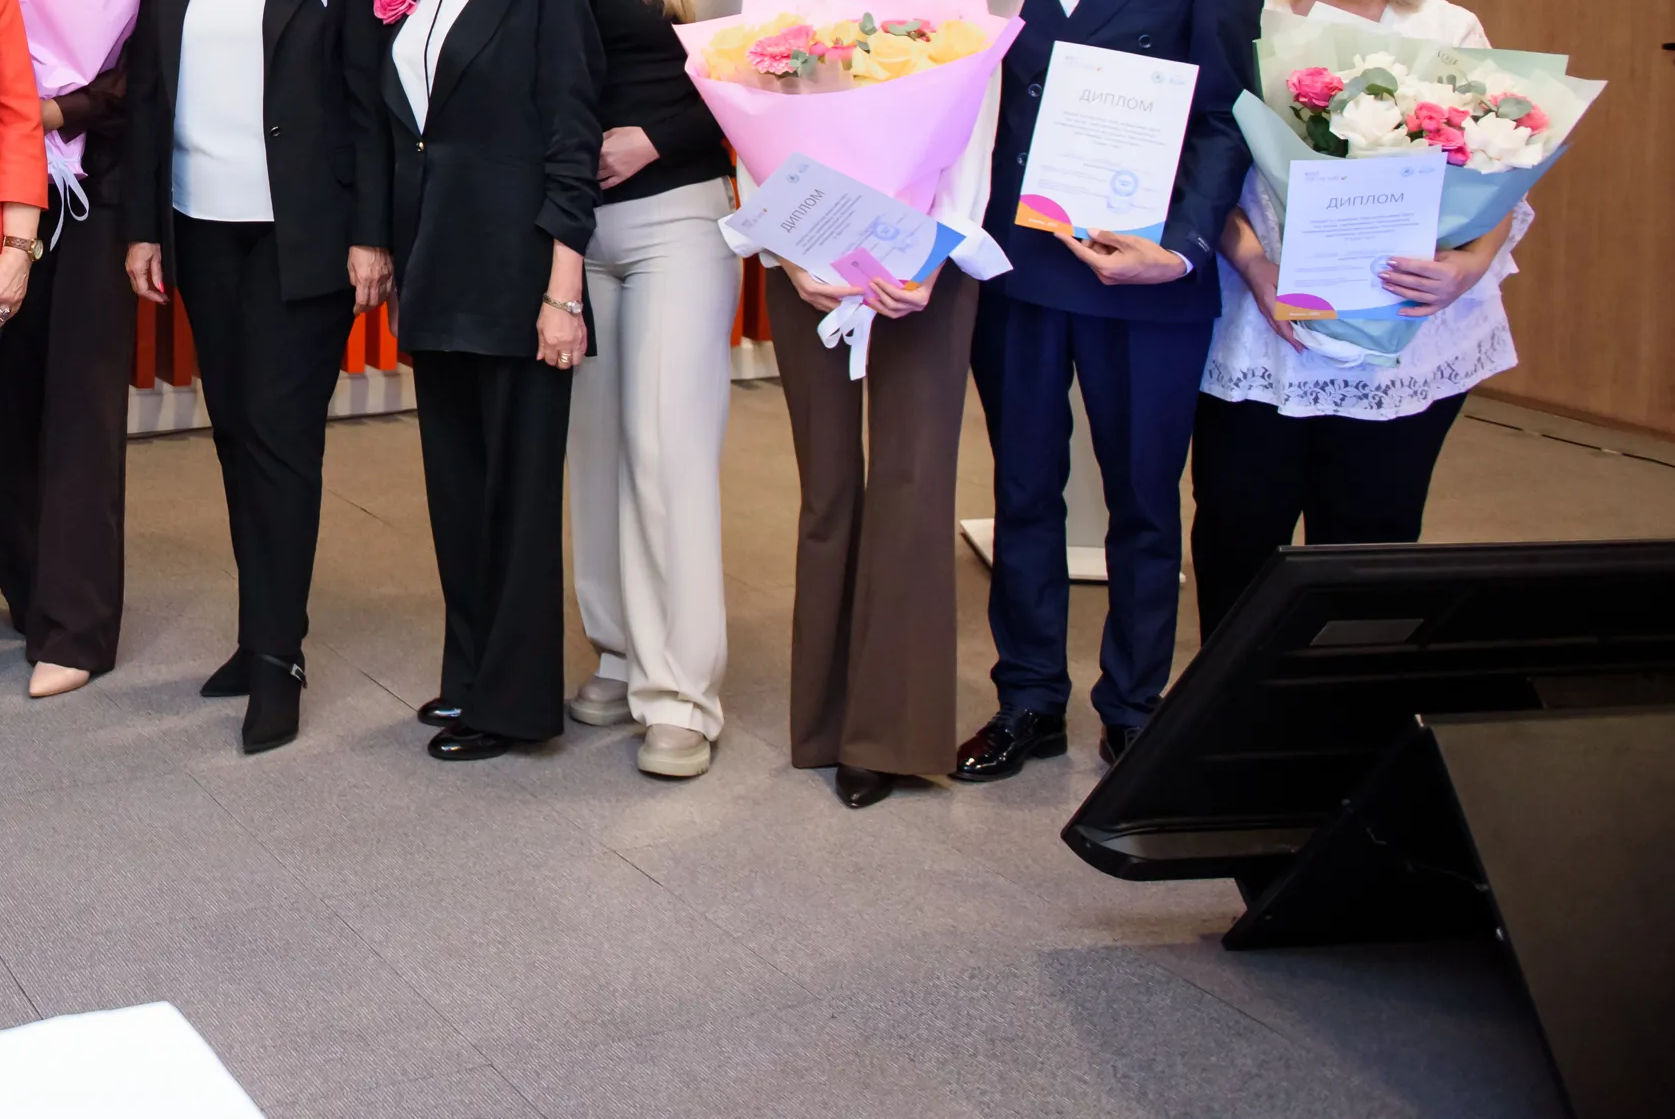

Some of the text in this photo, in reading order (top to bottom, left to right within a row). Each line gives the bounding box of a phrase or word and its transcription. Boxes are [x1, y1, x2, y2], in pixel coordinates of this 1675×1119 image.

[1078, 88, 1154, 114] ДИПЛОМ
[780, 188, 826, 234] ДИПЛОМ
[1325, 191, 1405, 210] ДИПЛОМ
